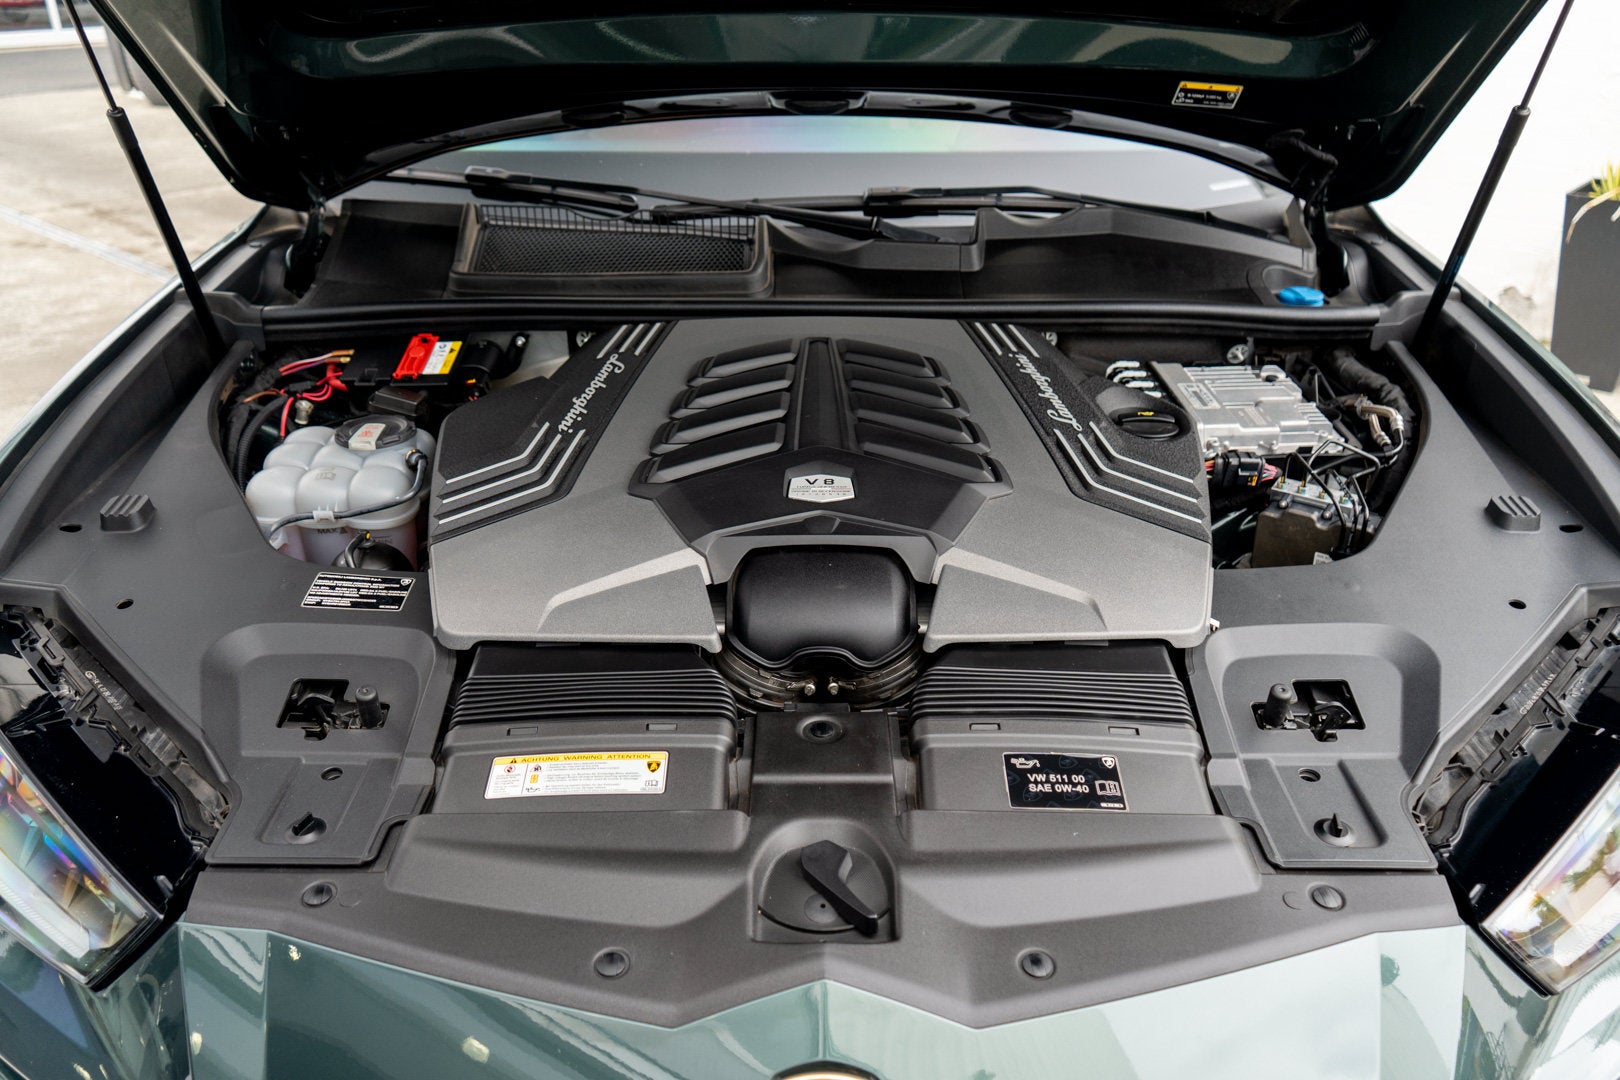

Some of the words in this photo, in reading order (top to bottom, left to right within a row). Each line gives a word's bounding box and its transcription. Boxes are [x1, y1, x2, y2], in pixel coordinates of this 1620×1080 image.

[558, 353, 625, 433] Lamborghini
[1008, 353, 1083, 432] Lamborghini
[1027, 773, 1046, 782] VW
[1049, 774, 1069, 782] 511
[1071, 774, 1086, 783] 00
[1028, 783, 1053, 792] SAE
[1055, 784, 1090, 793] 0W-40
